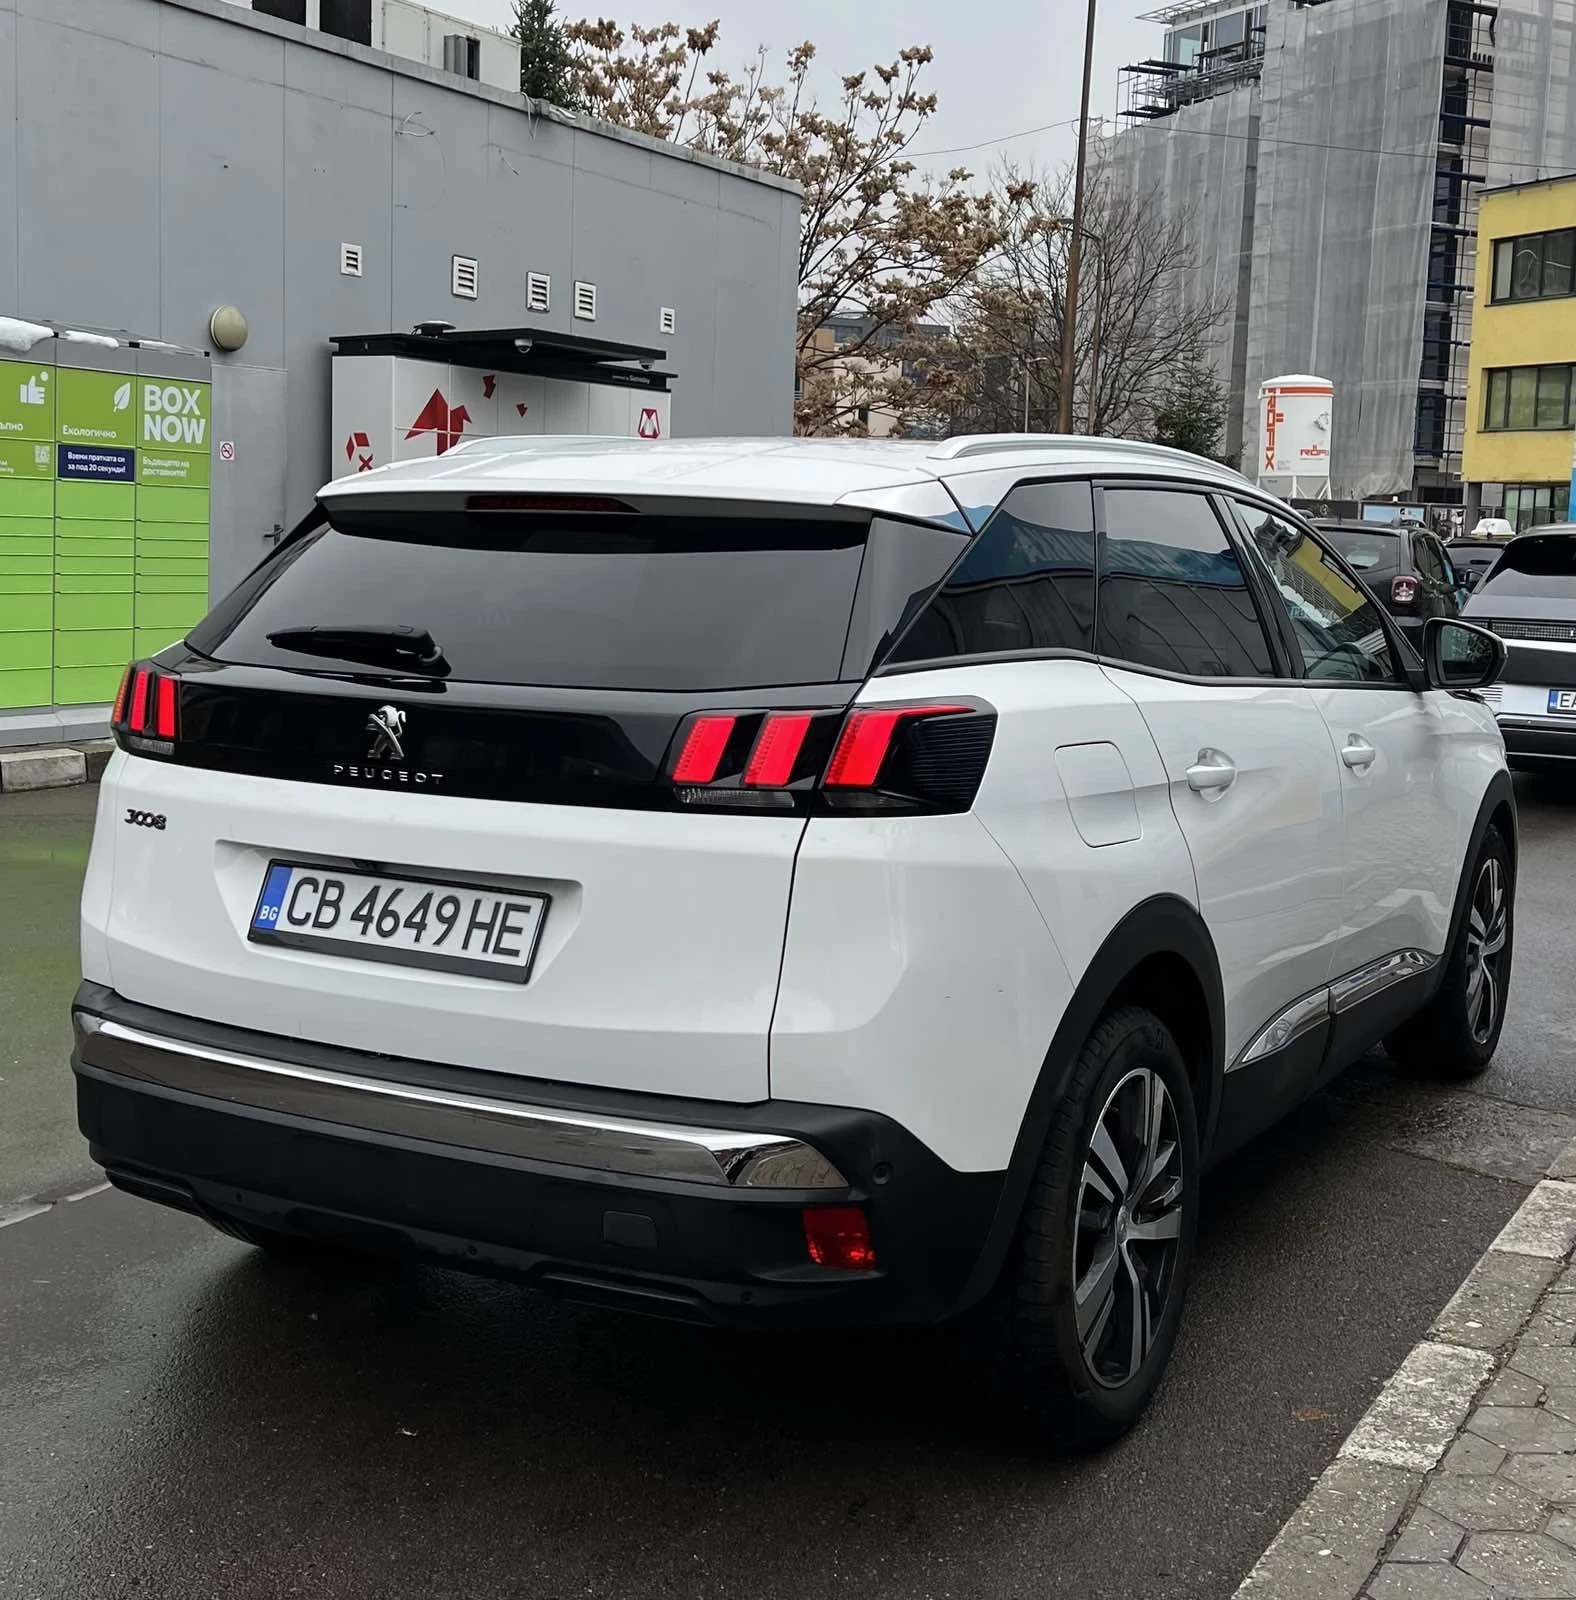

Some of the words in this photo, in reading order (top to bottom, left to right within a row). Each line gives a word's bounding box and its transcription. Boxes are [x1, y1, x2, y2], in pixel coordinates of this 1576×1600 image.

[144, 384, 201, 416] BOX
[62, 424, 117, 439] Екологично
[144, 414, 207, 444] NOW
[67, 451, 88, 460] Вземи
[88, 454, 117, 462] пратката
[75, 464, 88, 472] под
[88, 463, 97, 471] 20
[333, 764, 444, 785] PEUGEOT
[123, 808, 168, 831] 3008
[259, 905, 279, 921] BG
[286, 876, 346, 930] CB
[350, 884, 461, 947] 4649
[461, 898, 532, 958] HE
